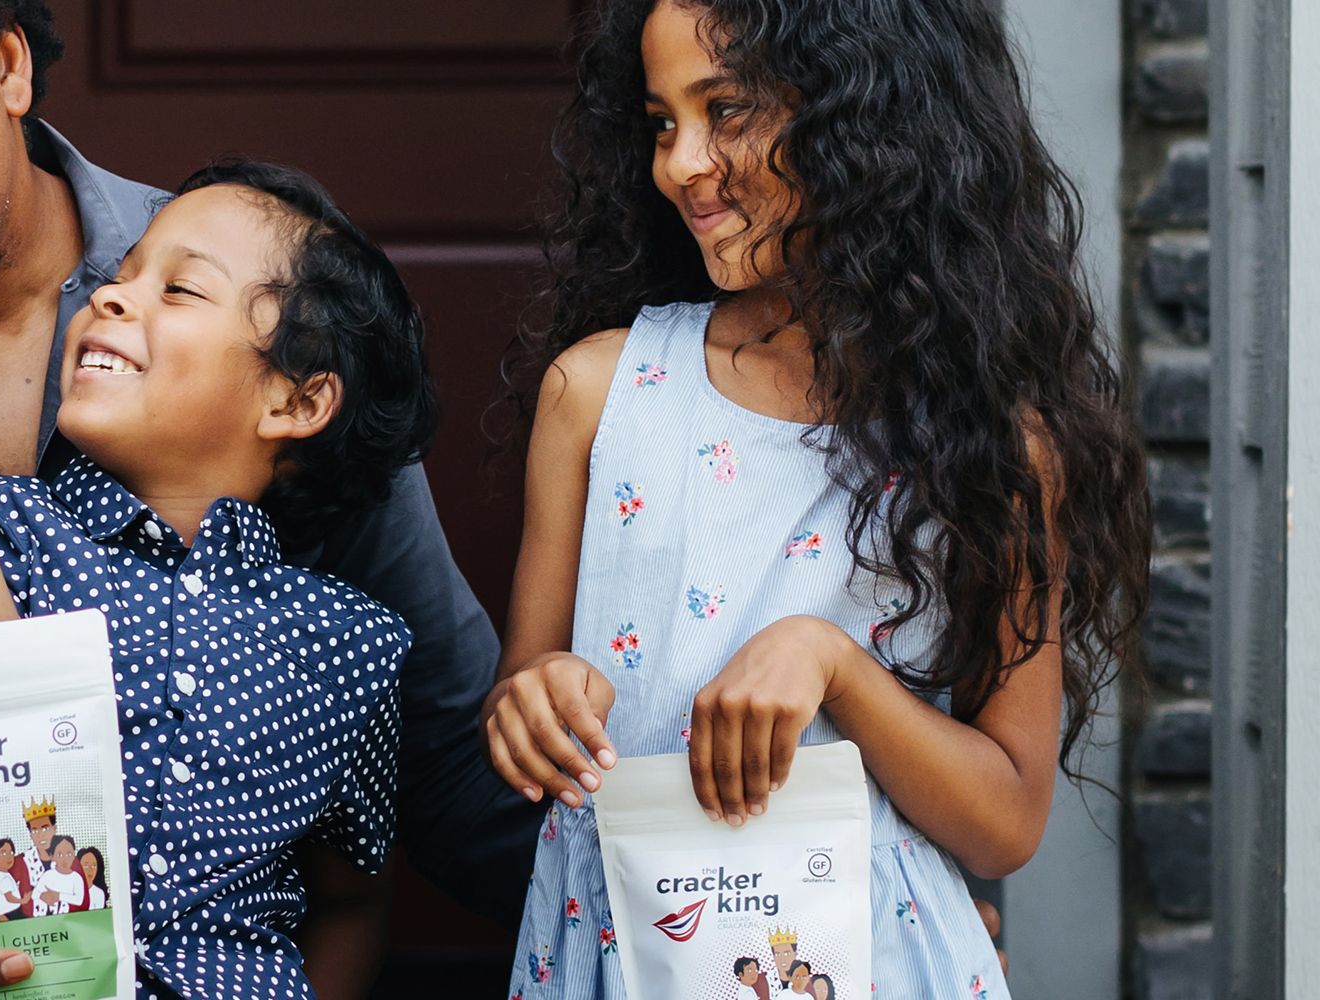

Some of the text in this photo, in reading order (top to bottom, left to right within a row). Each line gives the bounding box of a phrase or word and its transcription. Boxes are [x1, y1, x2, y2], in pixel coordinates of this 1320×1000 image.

[49, 713, 77, 722] Certified
[57, 728, 72, 738] GF
[812, 860, 827, 870] GF
[701, 867, 718, 875] the
[656, 866, 763, 894] cracker
[717, 890, 779, 916] king
[12, 931, 69, 948] GLUTEN
